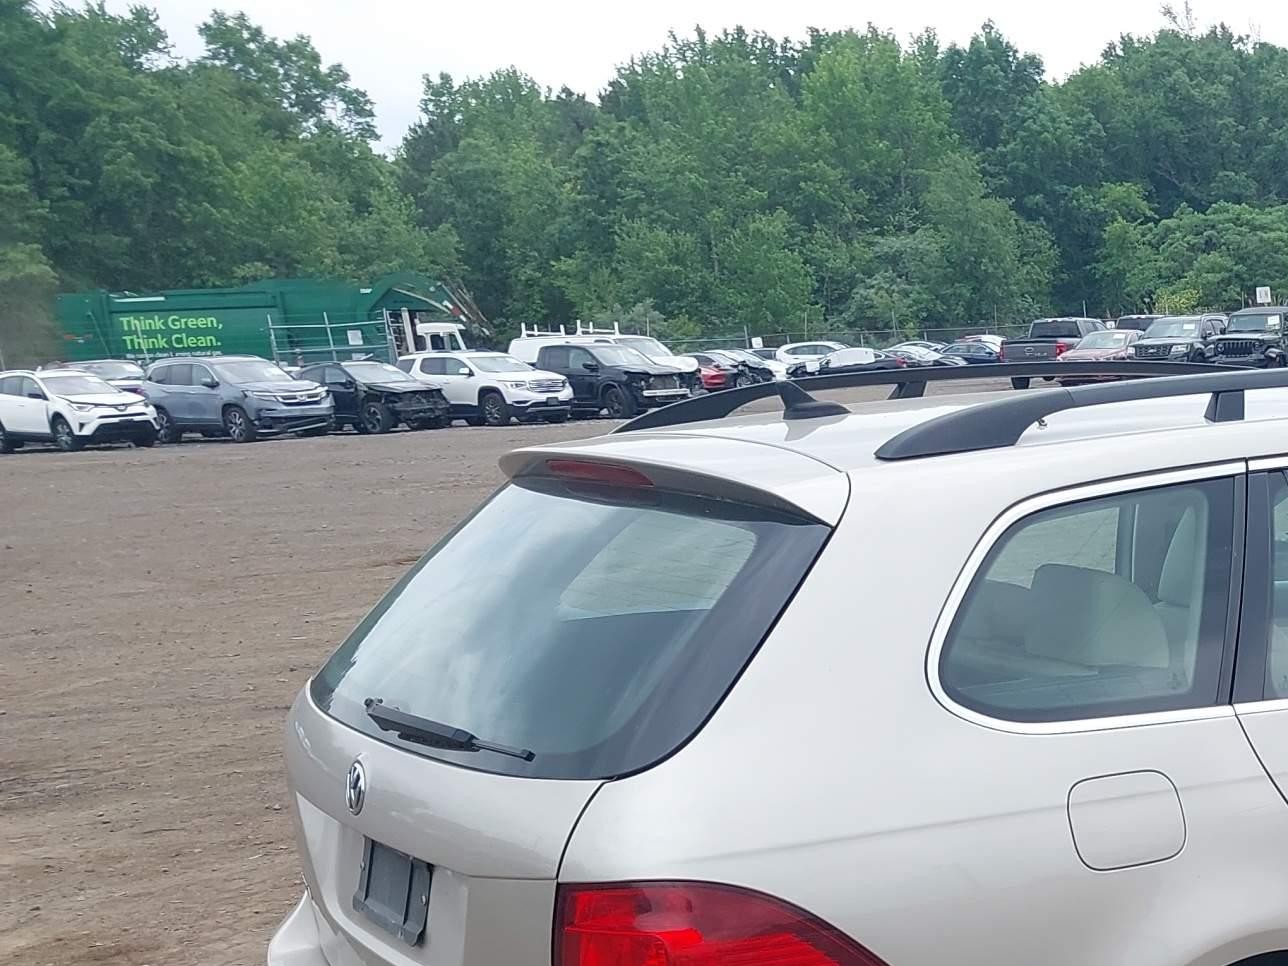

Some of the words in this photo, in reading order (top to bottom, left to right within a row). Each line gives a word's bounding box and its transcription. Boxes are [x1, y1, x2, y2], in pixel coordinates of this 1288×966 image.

[120, 315, 166, 331] Think
[168, 315, 223, 329] Green,
[122, 333, 169, 350] Think
[171, 333, 222, 348] Clean.
